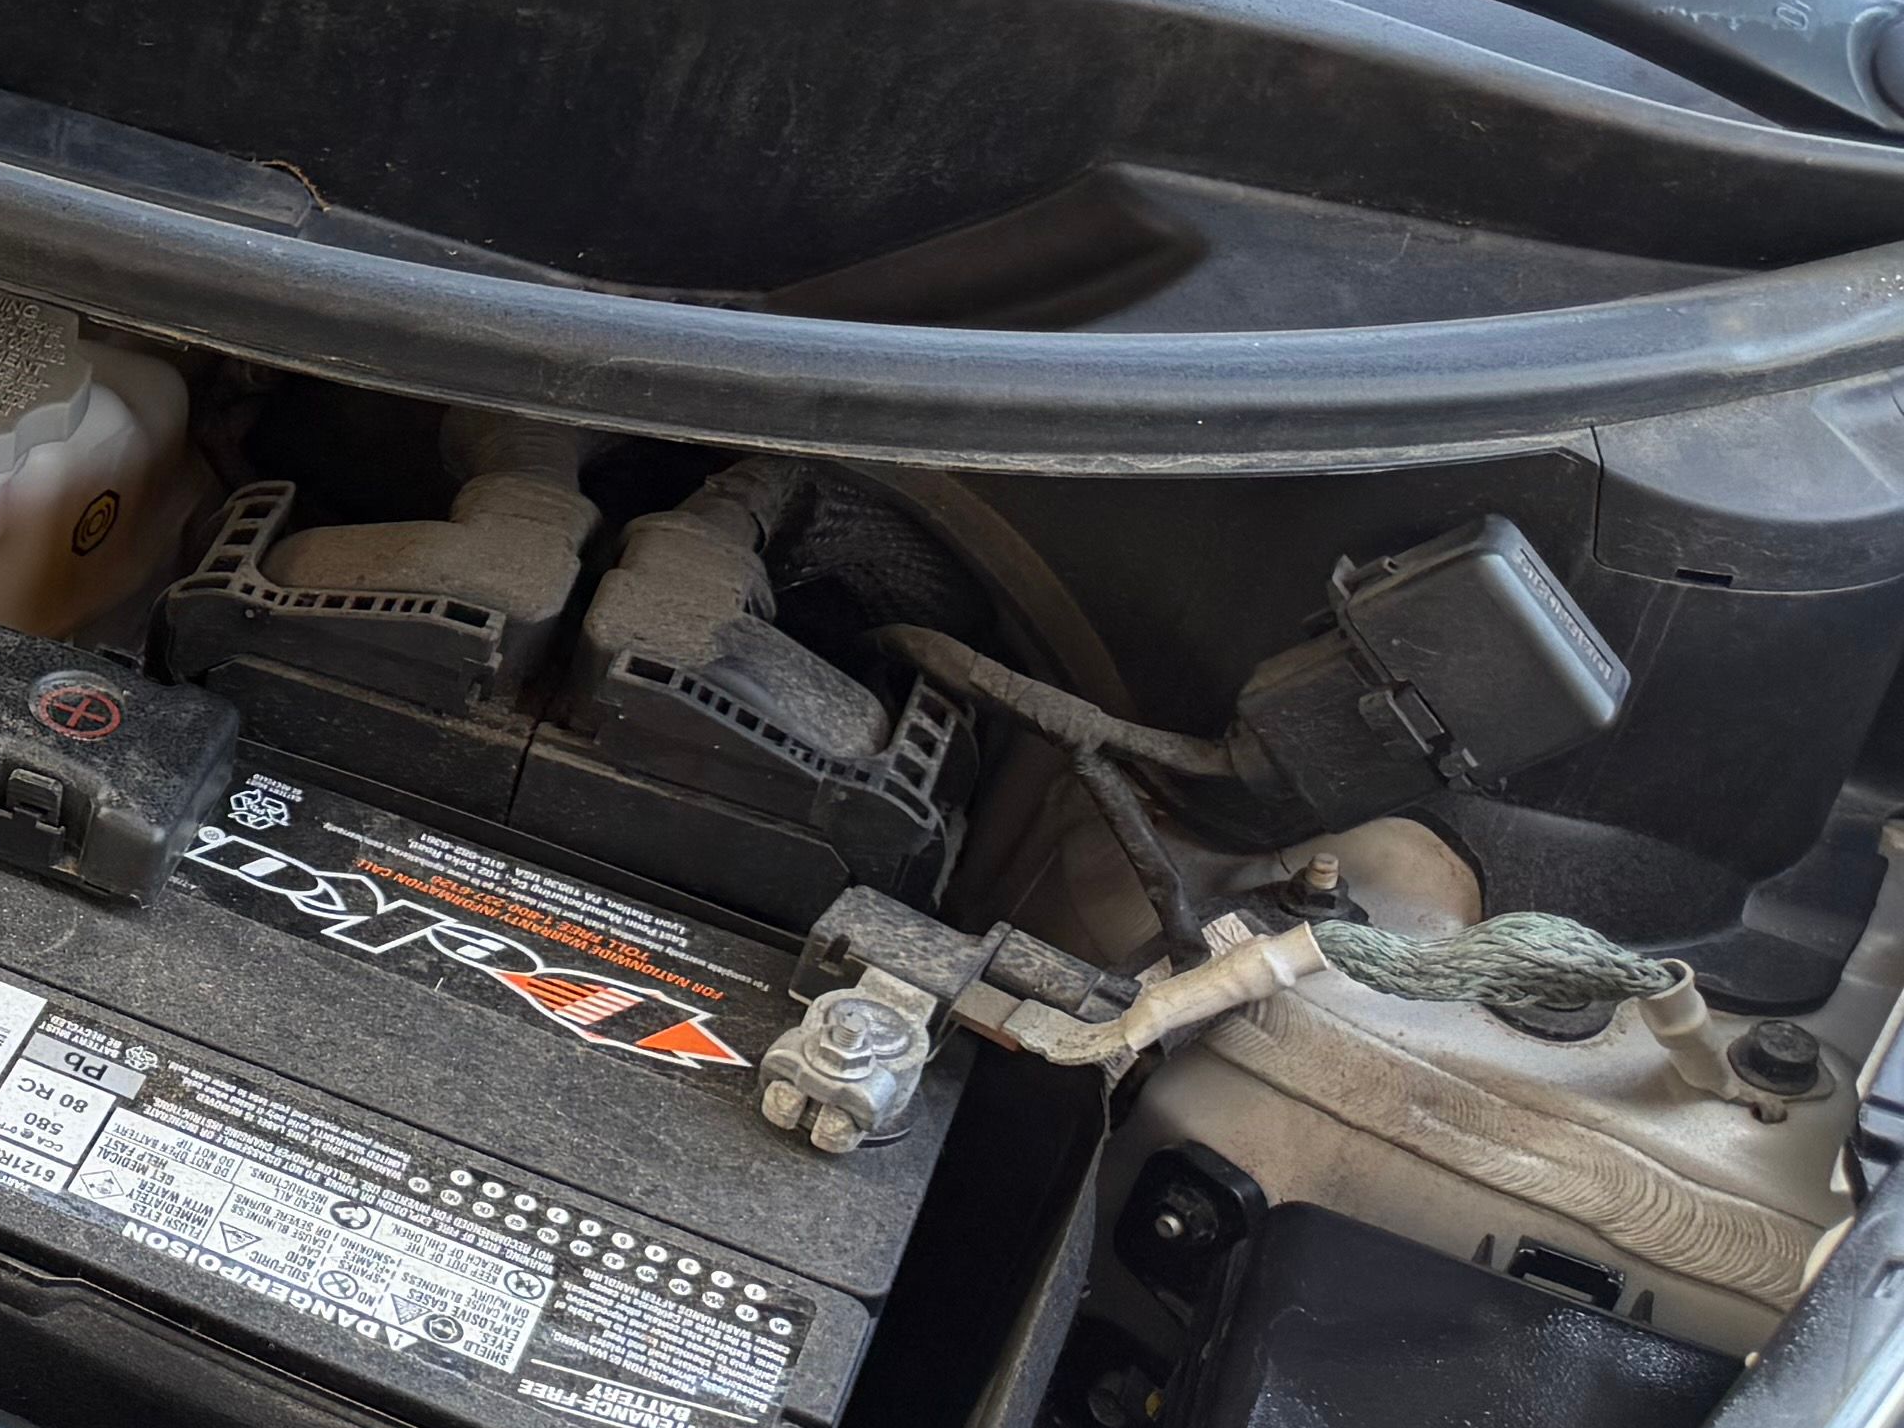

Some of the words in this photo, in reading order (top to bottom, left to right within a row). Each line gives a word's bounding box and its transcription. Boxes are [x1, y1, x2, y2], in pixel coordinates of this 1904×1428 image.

[391, 871, 501, 918] INFORMATION
[530, 882, 623, 923] Manufacturing
[498, 910, 588, 950] WARRANTY
[657, 929, 688, 948] East
[186, 827, 751, 1068] Deka
[606, 938, 650, 960] TOLL
[589, 944, 690, 988] NATIONWIDE
[691, 981, 723, 1000] FOR
[37, 1019, 71, 1039] MUST
[69, 1031, 120, 1058] BATTERY
[106, 1036, 122, 1048] BE
[59, 1049, 109, 1081] Pb
[15, 1075, 55, 1100] RC
[57, 1092, 89, 1114] 80
[22, 1110, 64, 1136] 580
[34, 1133, 64, 1152] CCA
[100, 1135, 136, 1157] FAST.
[109, 1122, 159, 1149] BATTERY.
[93, 1145, 149, 1175] MEDICAL
[136, 1149, 169, 1170] HELP
[158, 1141, 188, 1161] OPEN
[188, 1153, 212, 1170] NOT
[196, 1144, 218, 1160] NOT
[218, 1153, 235, 1167] DO
[150, 1167, 175, 1186] GET
[212, 1162, 229, 1177] DO
[0, 1174, 31, 1192] PART
[133, 1176, 180, 1202] WATER.
[245, 1164, 329, 1205] INSTRUCTIONS.
[181, 1195, 214, 1216] WITH
[271, 1187, 291, 1202] ALL
[292, 1195, 323, 1215] READ
[125, 1186, 209, 1227] IMMEDIATELY
[128, 1202, 161, 1223] EYES
[162, 1215, 202, 1239] FLUSH
[229, 1203, 290, 1234] BLINDNESS
[272, 1207, 314, 1231] SEVERE
[290, 1227, 327, 1249] CAUSE
[314, 1224, 332, 1238] OR
[388, 1222, 448, 1253] CHILDREN.
[284, 1249, 316, 1268] ACID
[297, 1242, 321, 1259] CAN
[403, 1240, 427, 1257] THE
[427, 1249, 444, 1263] OF
[448, 1245, 464, 1260] OF
[532, 1246, 554, 1263] NOT
[247, 1249, 310, 1283] SULFURIC
[444, 1256, 468, 1273] OUT
[465, 1252, 503, 1275] REACH
[120, 1220, 380, 1338] DANGER/POISON
[470, 1266, 498, 1285] KEEP
[356, 1290, 376, 1307] NO
[399, 1271, 462, 1304] BLINDNESS
[405, 1287, 448, 1312] GASES
[463, 1296, 500, 1318] CAUSE
[511, 1303, 529, 1318] OR
[450, 1305, 520, 1341] EXPLOSIVE
[502, 1312, 525, 1328] CAN
[462, 1338, 509, 1366] SHIELD
[476, 1330, 514, 1353] EYES.
[585, 1380, 691, 1423] BATTERY
